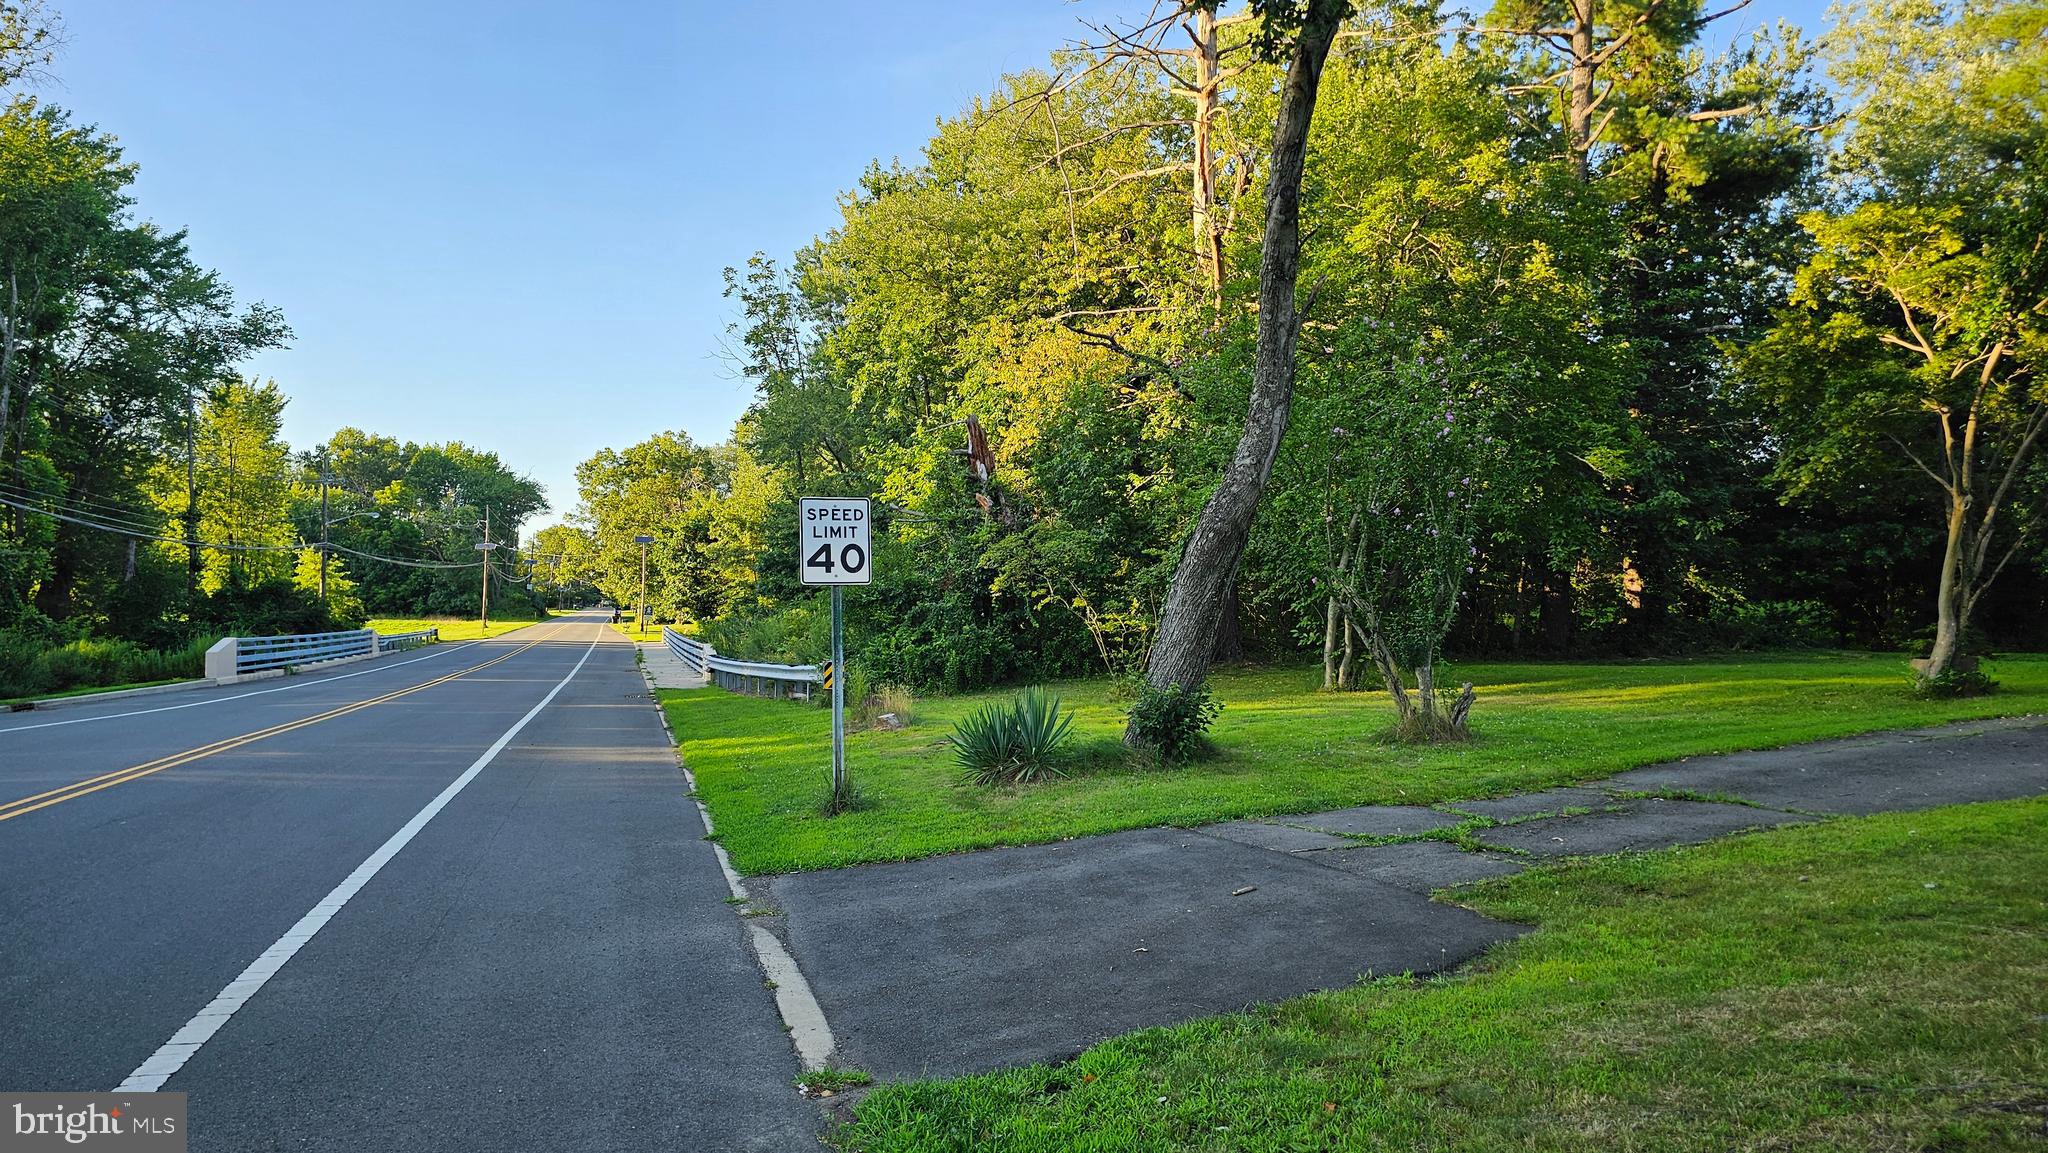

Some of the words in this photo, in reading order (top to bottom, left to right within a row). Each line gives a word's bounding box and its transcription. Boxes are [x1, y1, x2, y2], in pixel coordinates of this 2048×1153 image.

[807, 508, 863, 521] SPEED
[813, 526, 857, 538] LIMIT
[807, 543, 865, 573] 40
